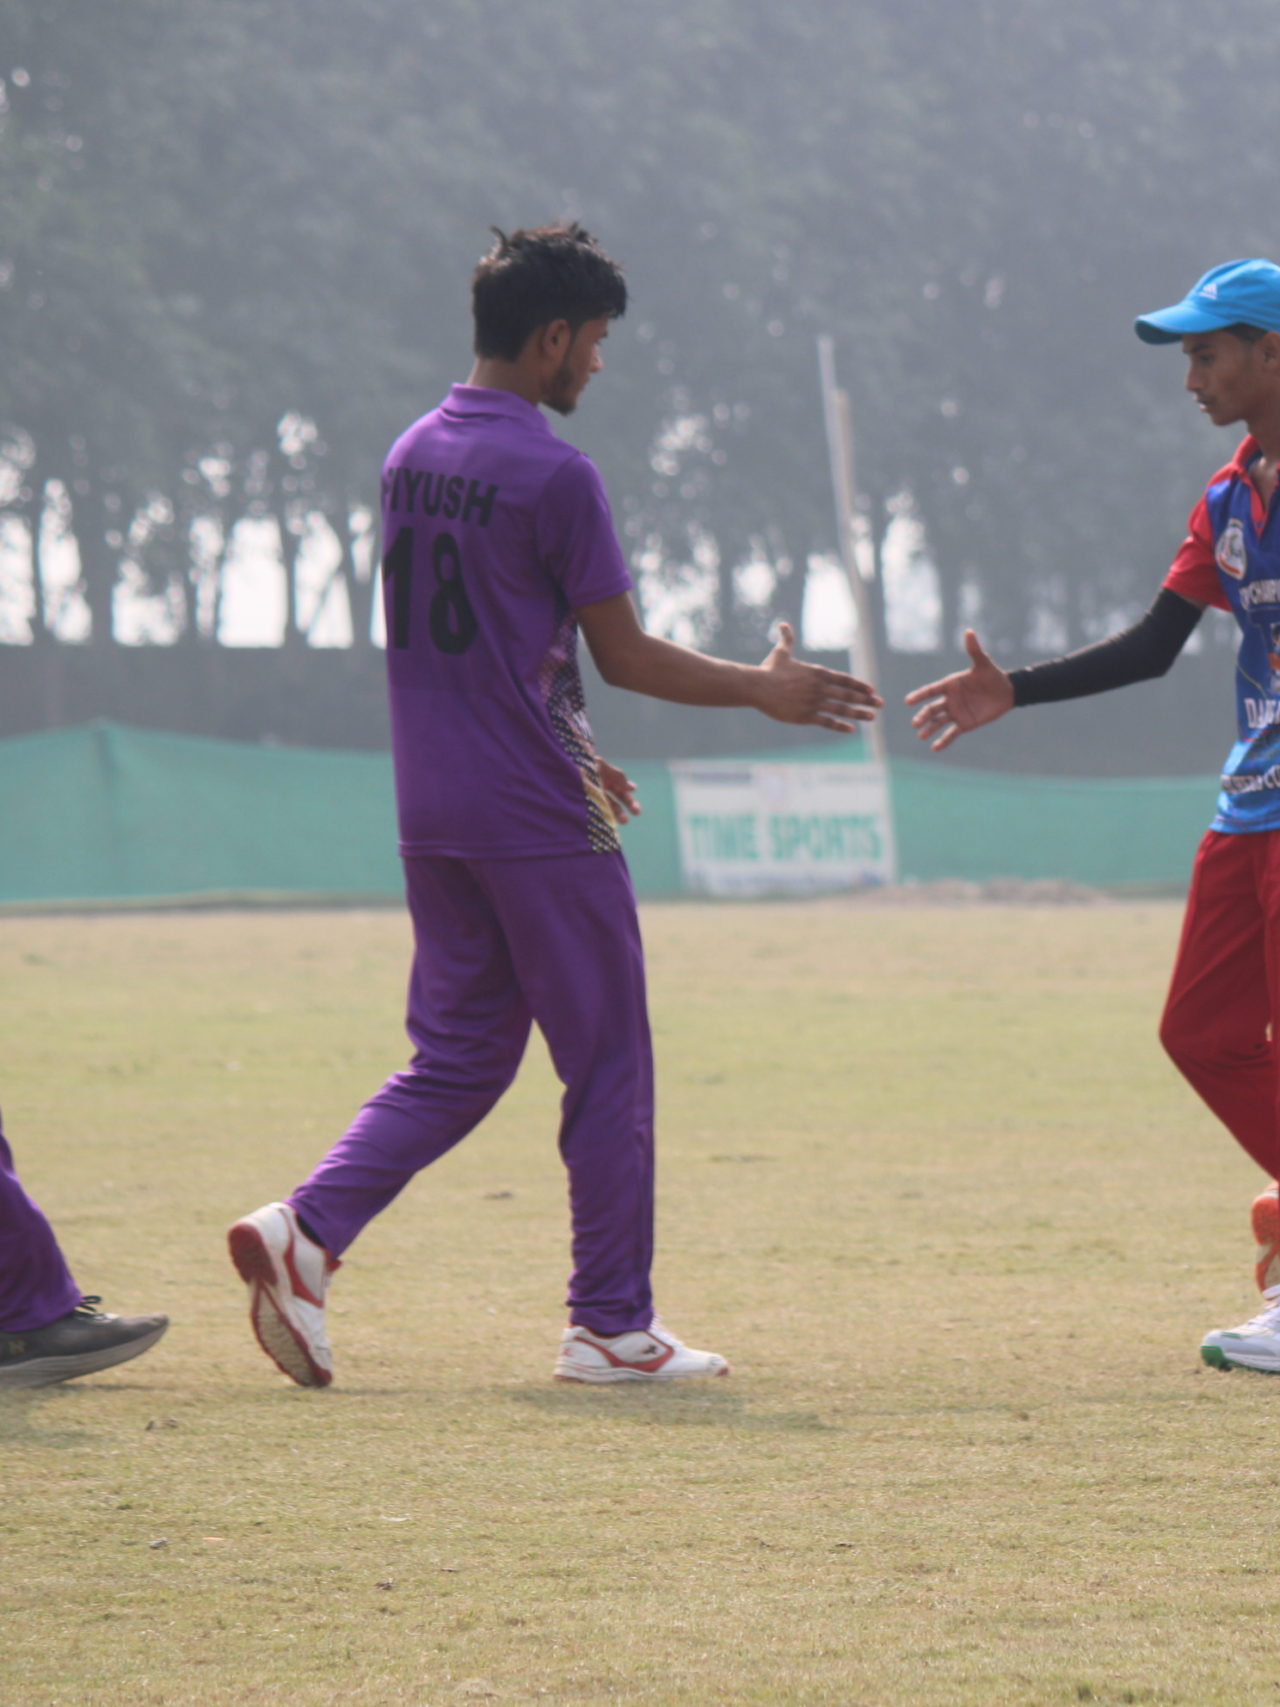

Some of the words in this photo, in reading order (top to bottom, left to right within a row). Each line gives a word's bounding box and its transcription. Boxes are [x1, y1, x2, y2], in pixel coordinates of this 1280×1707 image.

[383, 527, 478, 655] 18
[689, 813, 760, 862] TIME
[768, 812, 882, 863] SPORTS
